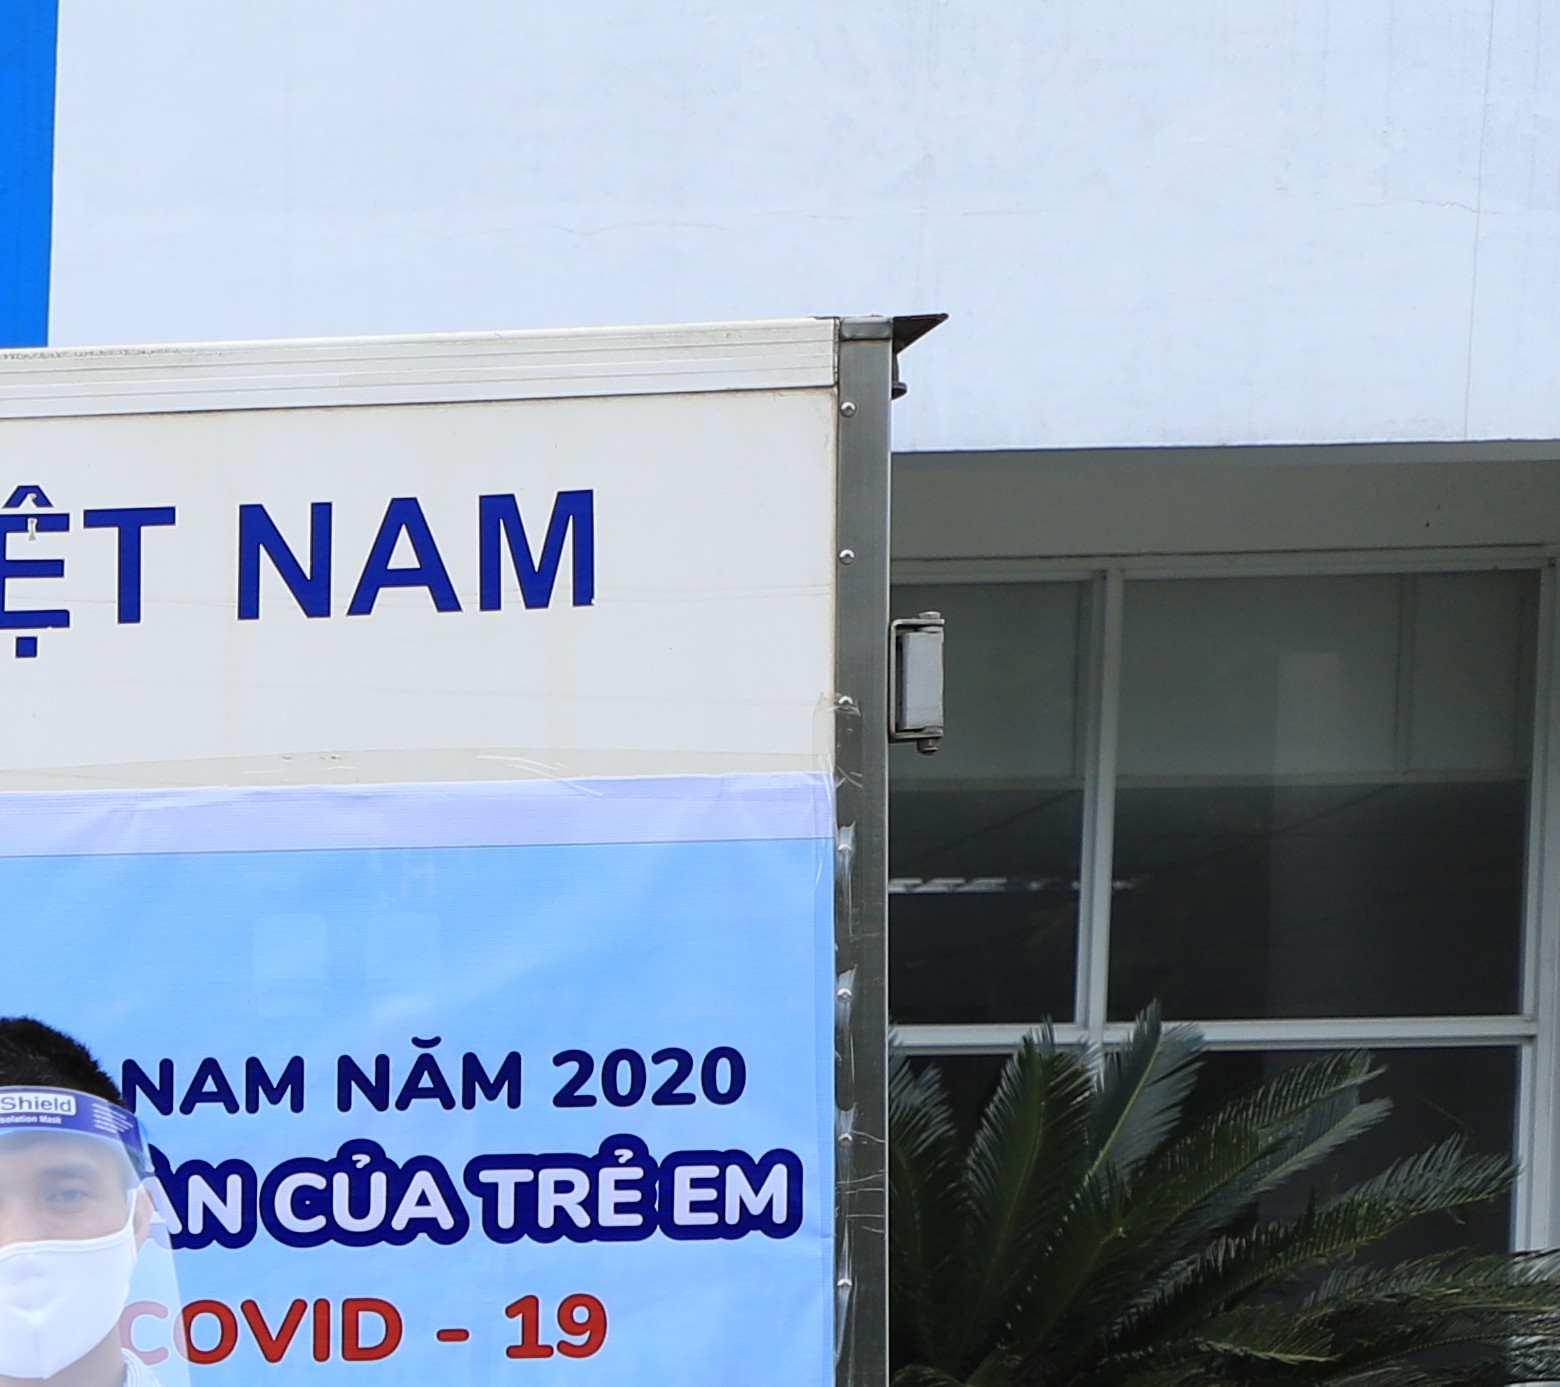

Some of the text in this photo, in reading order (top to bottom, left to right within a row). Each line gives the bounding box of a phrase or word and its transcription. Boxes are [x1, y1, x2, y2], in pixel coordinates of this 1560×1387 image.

[240, 490, 594, 618] NAM
[0, 1095, 73, 1113] Shield
[121, 1056, 305, 1117] NAM
[337, 1036, 521, 1112] NĂM
[553, 1046, 746, 1107] 2020
[39, 1115, 63, 1125] Mask
[275, 1155, 453, 1231] CỦA
[478, 1150, 646, 1232] TRẺ
[674, 1164, 787, 1224] EM
[123, 1297, 403, 1367] COVID
[439, 1330, 467, 1341] -
[508, 1295, 606, 1358] 19
